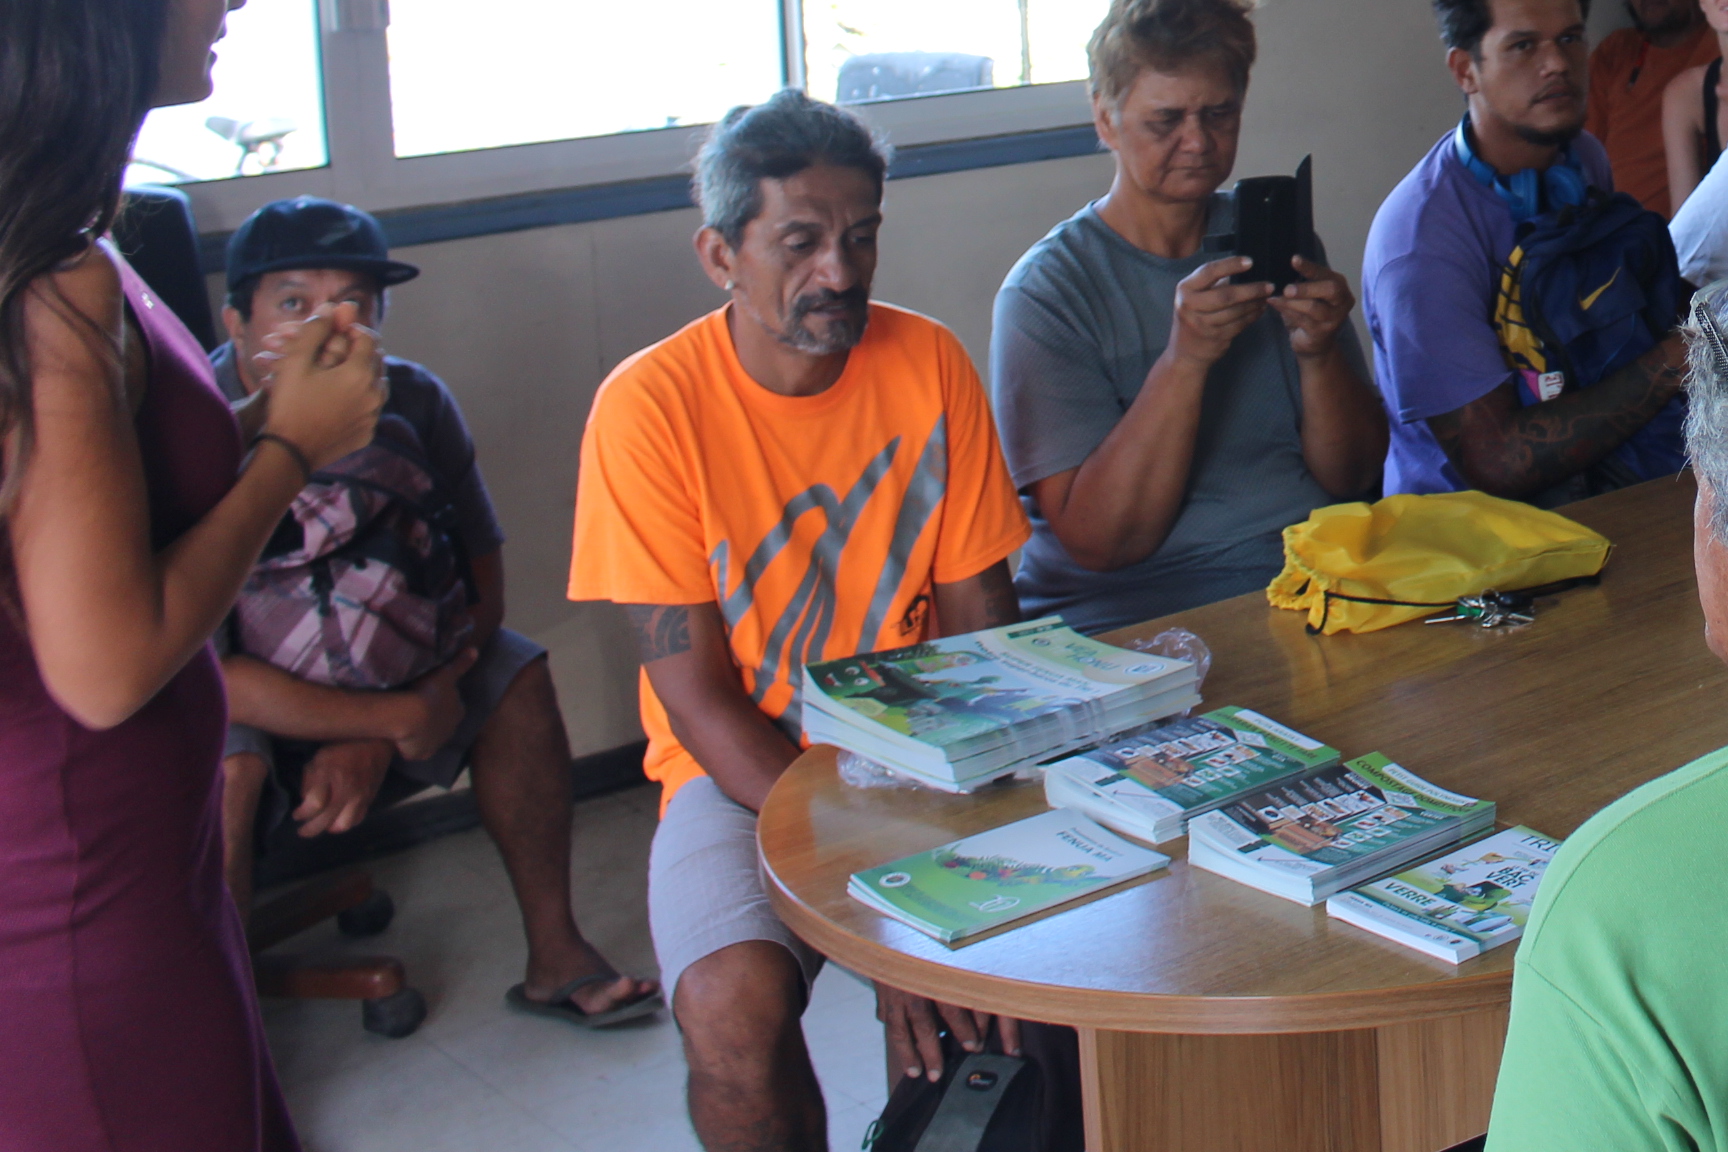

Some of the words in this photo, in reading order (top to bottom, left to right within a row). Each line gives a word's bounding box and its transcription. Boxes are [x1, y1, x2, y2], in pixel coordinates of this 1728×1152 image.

[1355, 758, 1415, 795] COMPOSTAGE
[1056, 829, 1094, 853] FENUA
[1092, 851, 1113, 862] MA
[1486, 872, 1530, 889] VERT
[1498, 866, 1537, 882] BAC
[1384, 882, 1437, 907] VERRE
